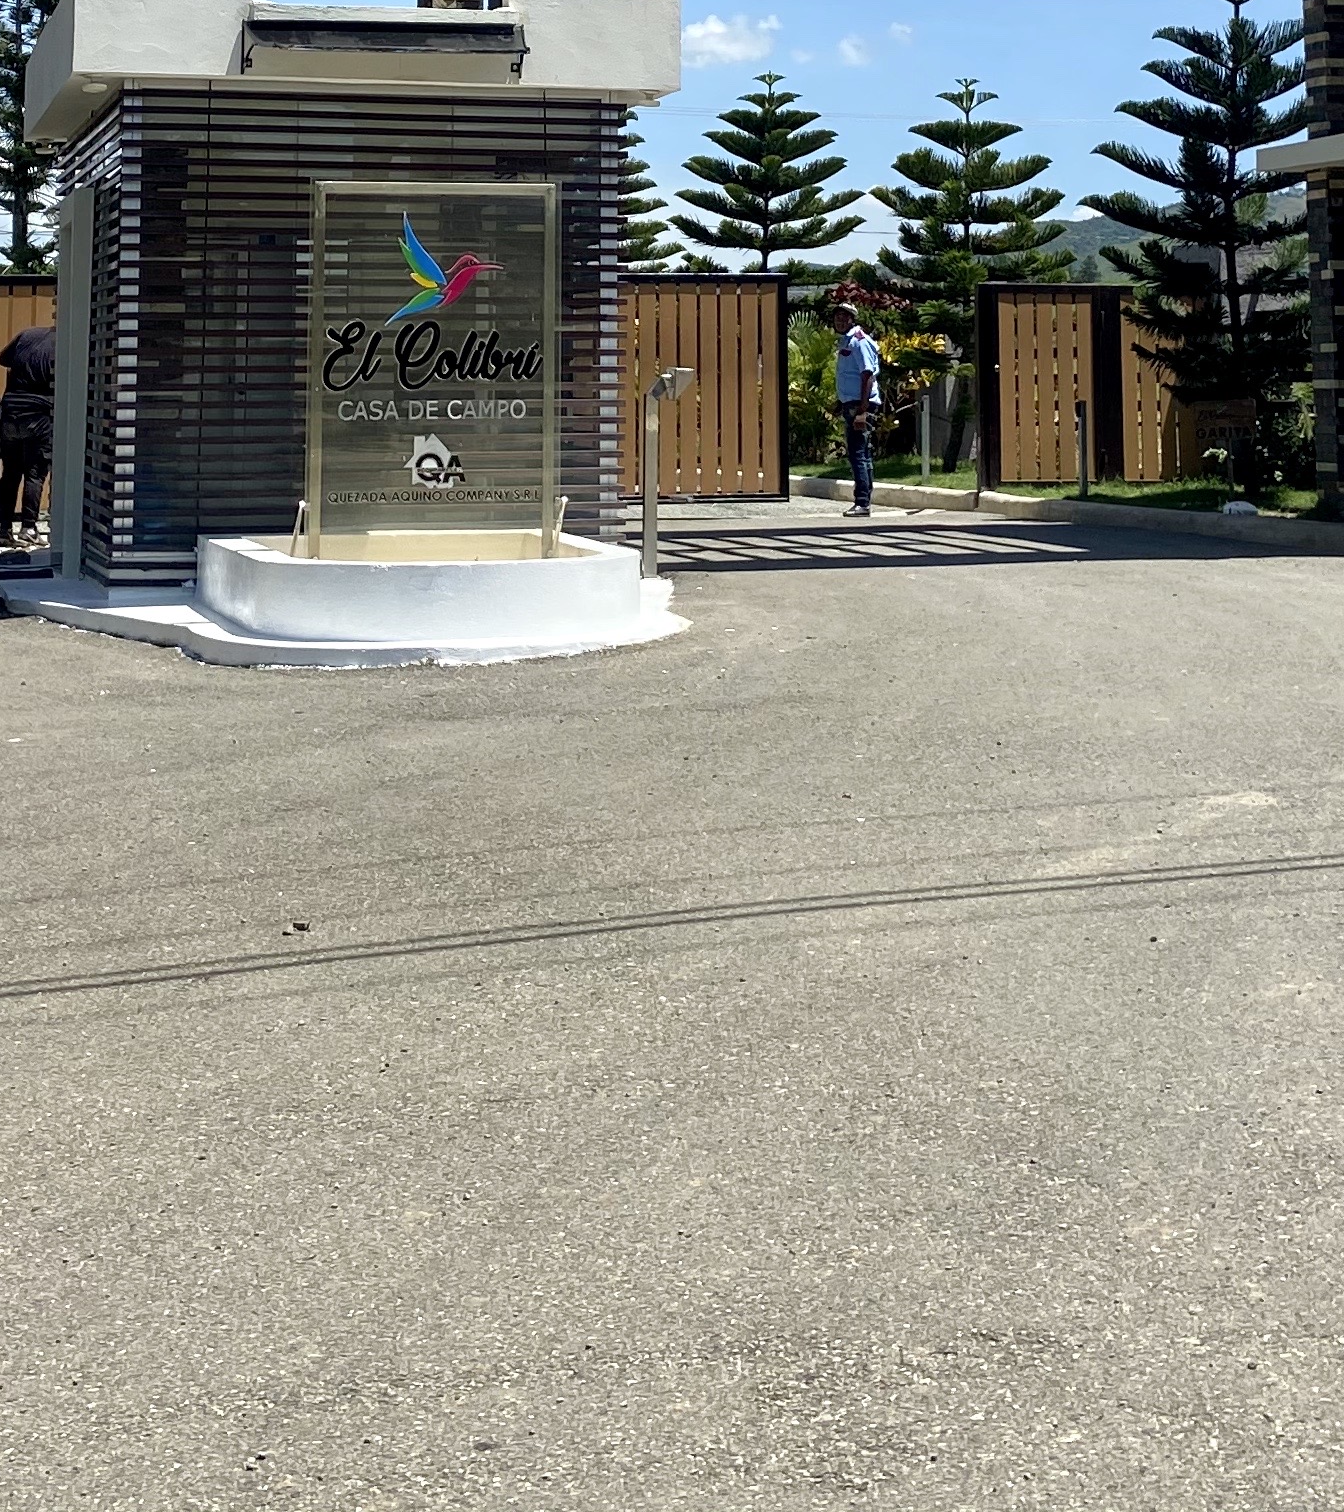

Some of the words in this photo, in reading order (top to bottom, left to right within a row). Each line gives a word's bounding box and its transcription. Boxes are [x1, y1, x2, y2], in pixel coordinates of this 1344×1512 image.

[323, 319, 383, 391] El
[337, 400, 399, 421] CASA
[408, 400, 439, 420] DE
[446, 399, 527, 420] CAMPO
[415, 453, 466, 483] QA
[327, 490, 387, 503] QUEZADA
[391, 490, 443, 502] AQUINO
[446, 490, 510, 502] COMPANY
